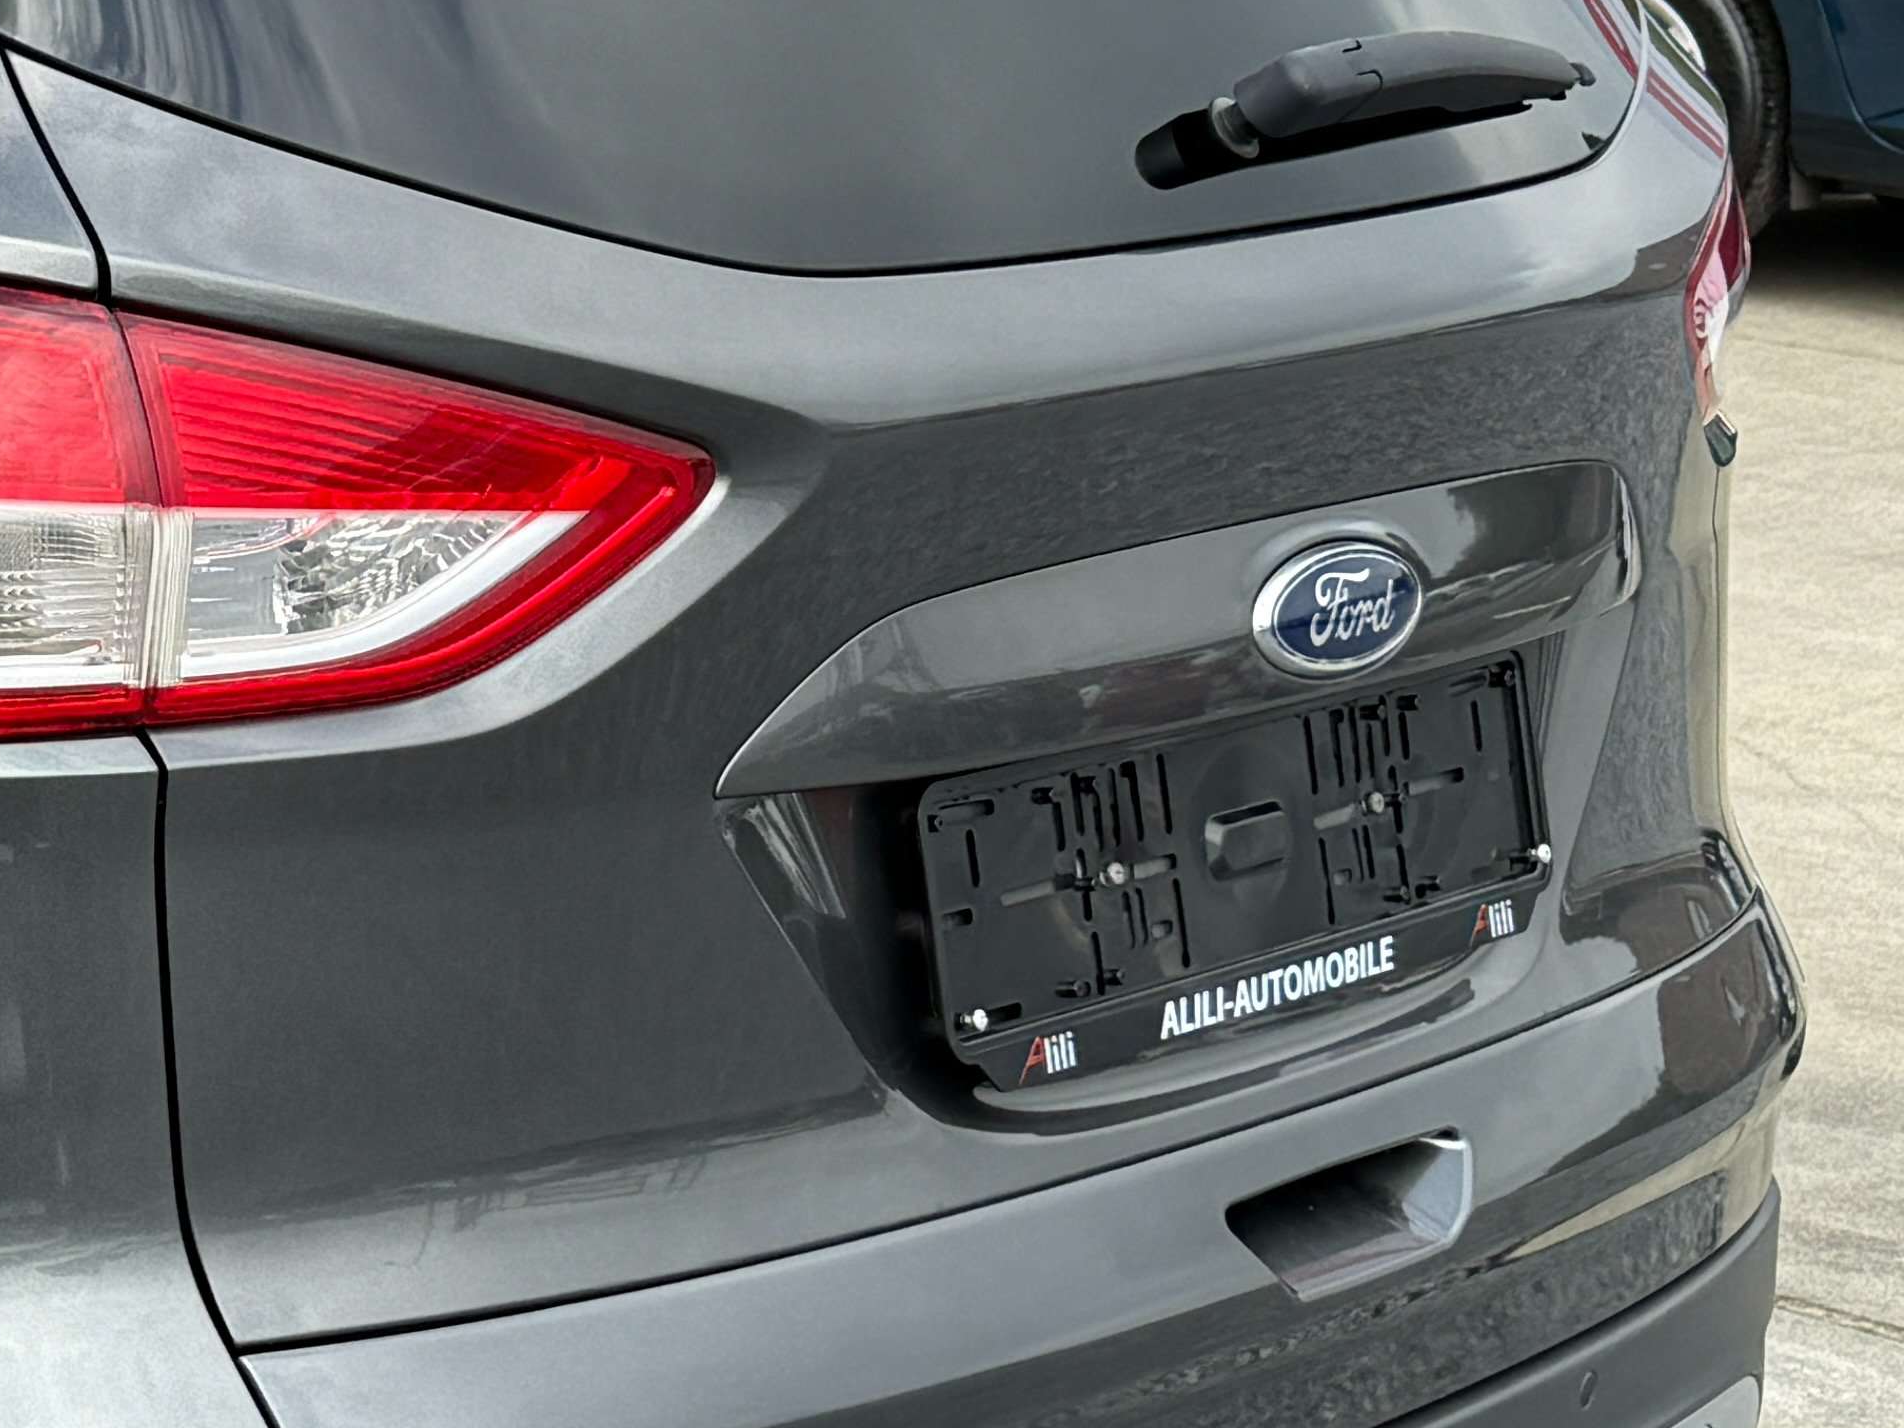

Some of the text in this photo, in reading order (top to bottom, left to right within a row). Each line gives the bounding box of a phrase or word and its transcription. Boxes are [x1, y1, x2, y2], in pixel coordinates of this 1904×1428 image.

[1310, 568, 1397, 647] Ford
[1469, 899, 1515, 947] Alili
[1160, 935, 1395, 1040] ALILI-AUTOMOBILE
[1019, 1030, 1077, 1086] Alili
